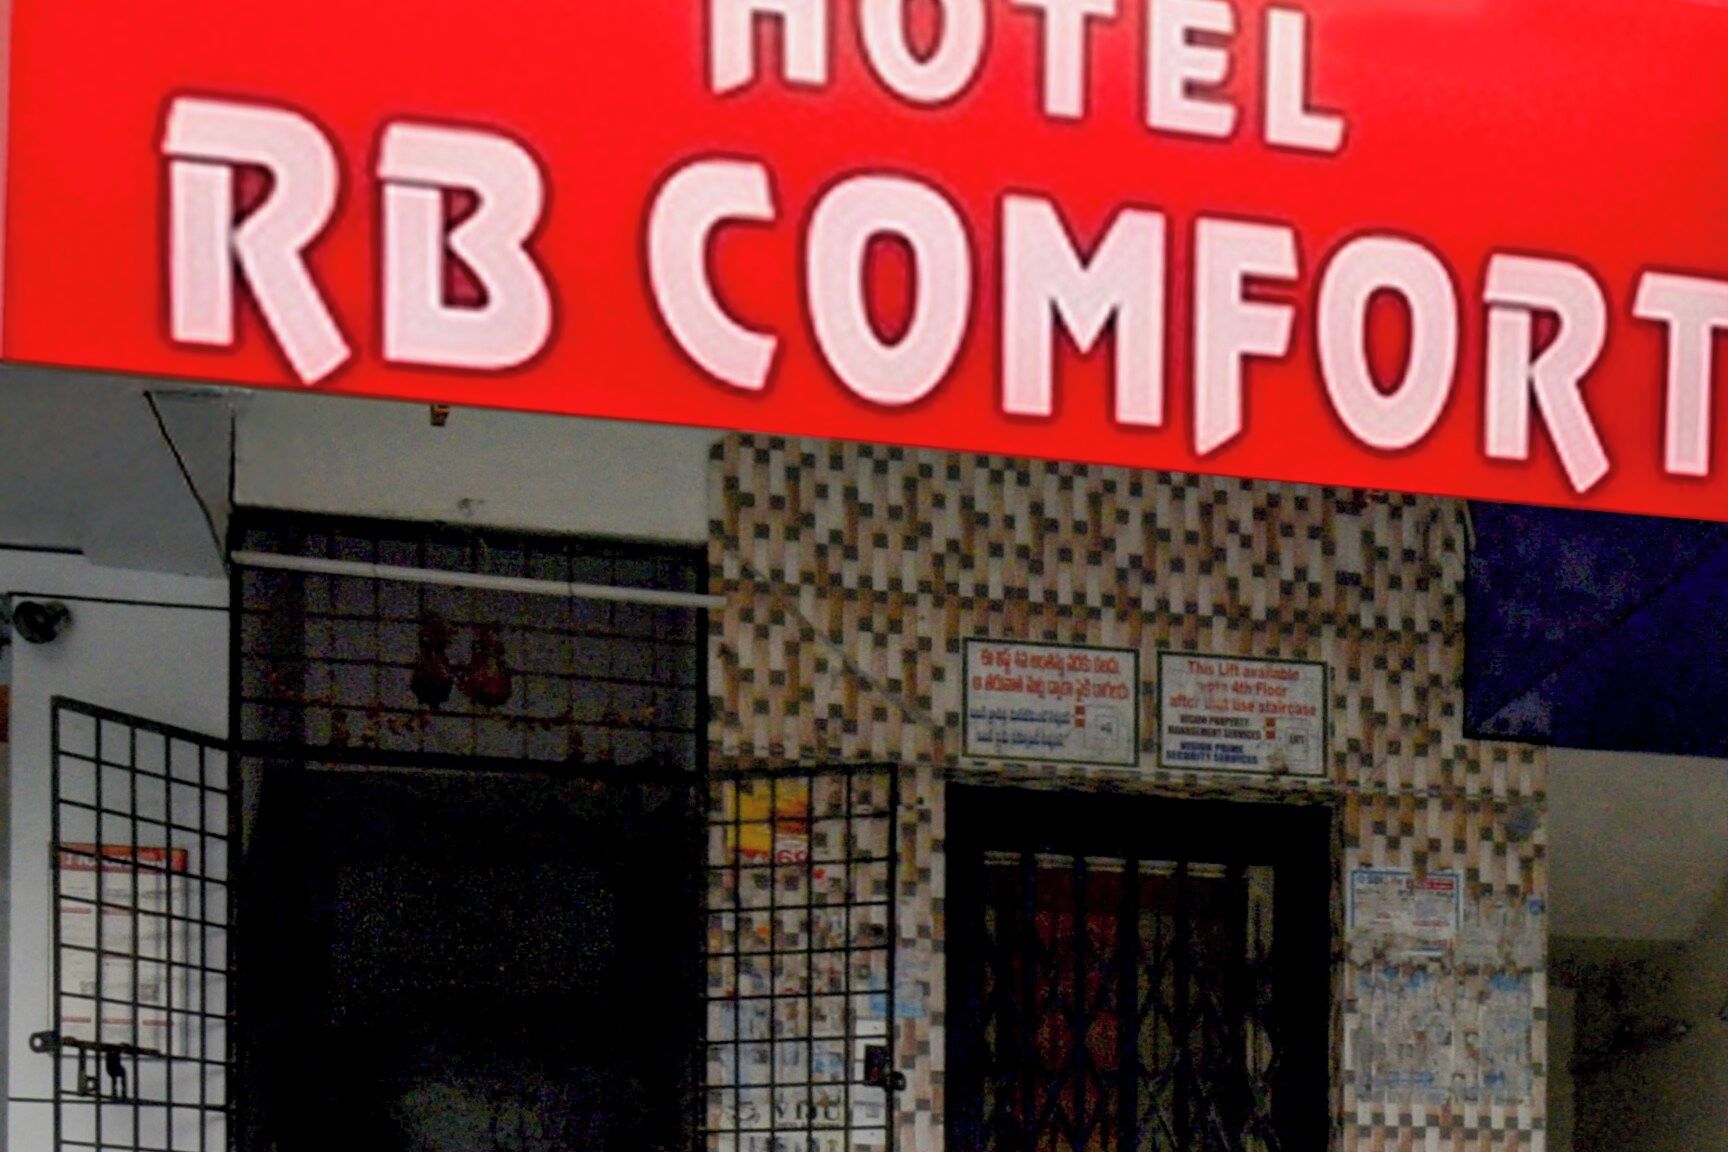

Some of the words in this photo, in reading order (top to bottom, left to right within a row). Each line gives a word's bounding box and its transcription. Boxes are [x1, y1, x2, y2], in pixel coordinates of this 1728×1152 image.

[708, 0, 1346, 153] HOTEL
[162, 97, 553, 385] RB
[1188, 660, 1214, 676] This
[1218, 662, 1240, 677] Lift
[1243, 665, 1299, 682] available
[1256, 682, 1288, 697] Floor
[1258, 701, 1317, 717] staircase
